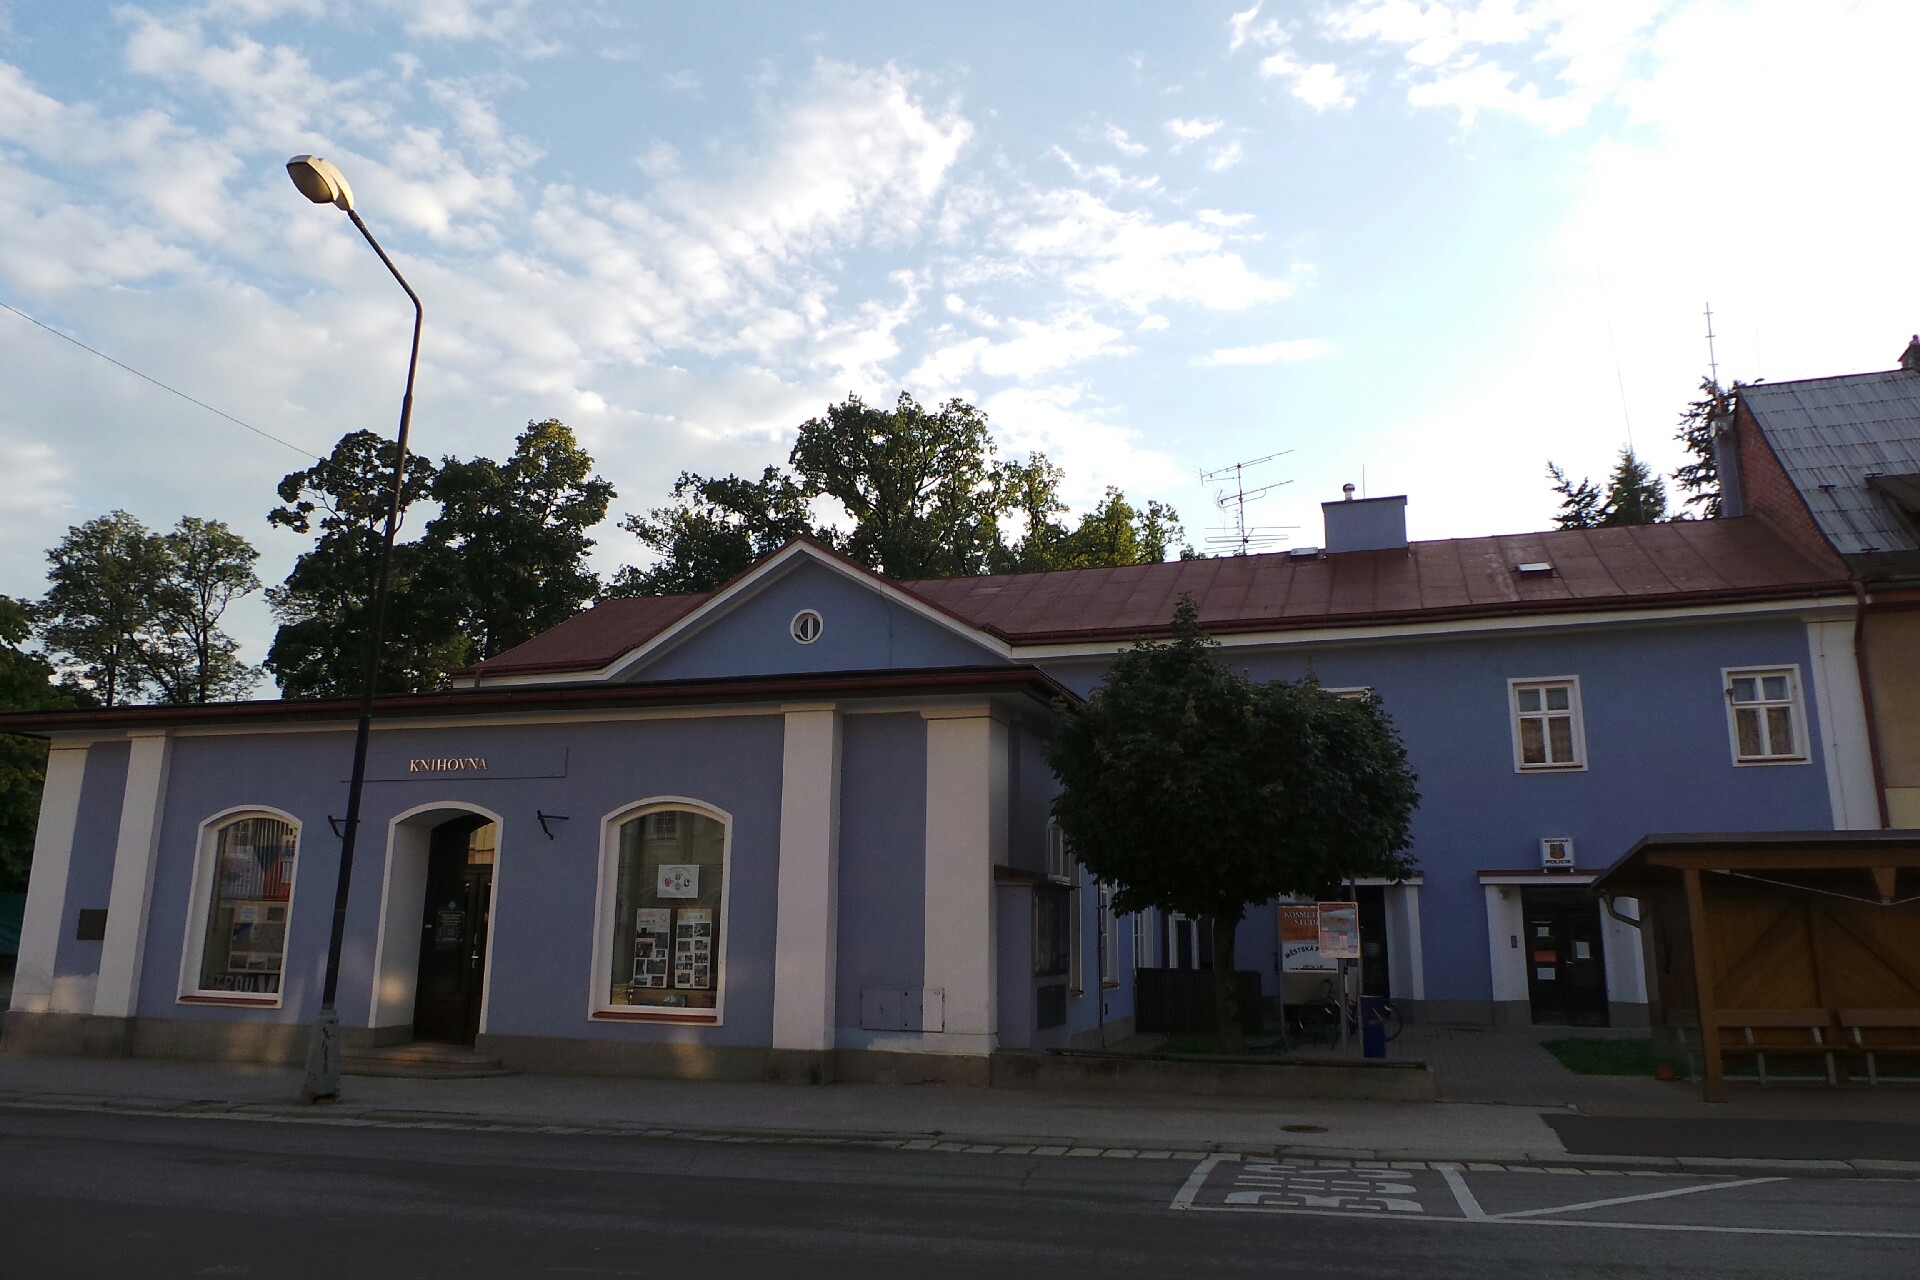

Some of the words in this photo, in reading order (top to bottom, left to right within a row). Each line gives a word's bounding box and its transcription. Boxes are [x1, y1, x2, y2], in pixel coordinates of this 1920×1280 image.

[409, 757, 488, 772] KNIHOVNA
[1284, 945, 1314, 959] MĚSTSKÁ
[1224, 1164, 1424, 1213] BUS
